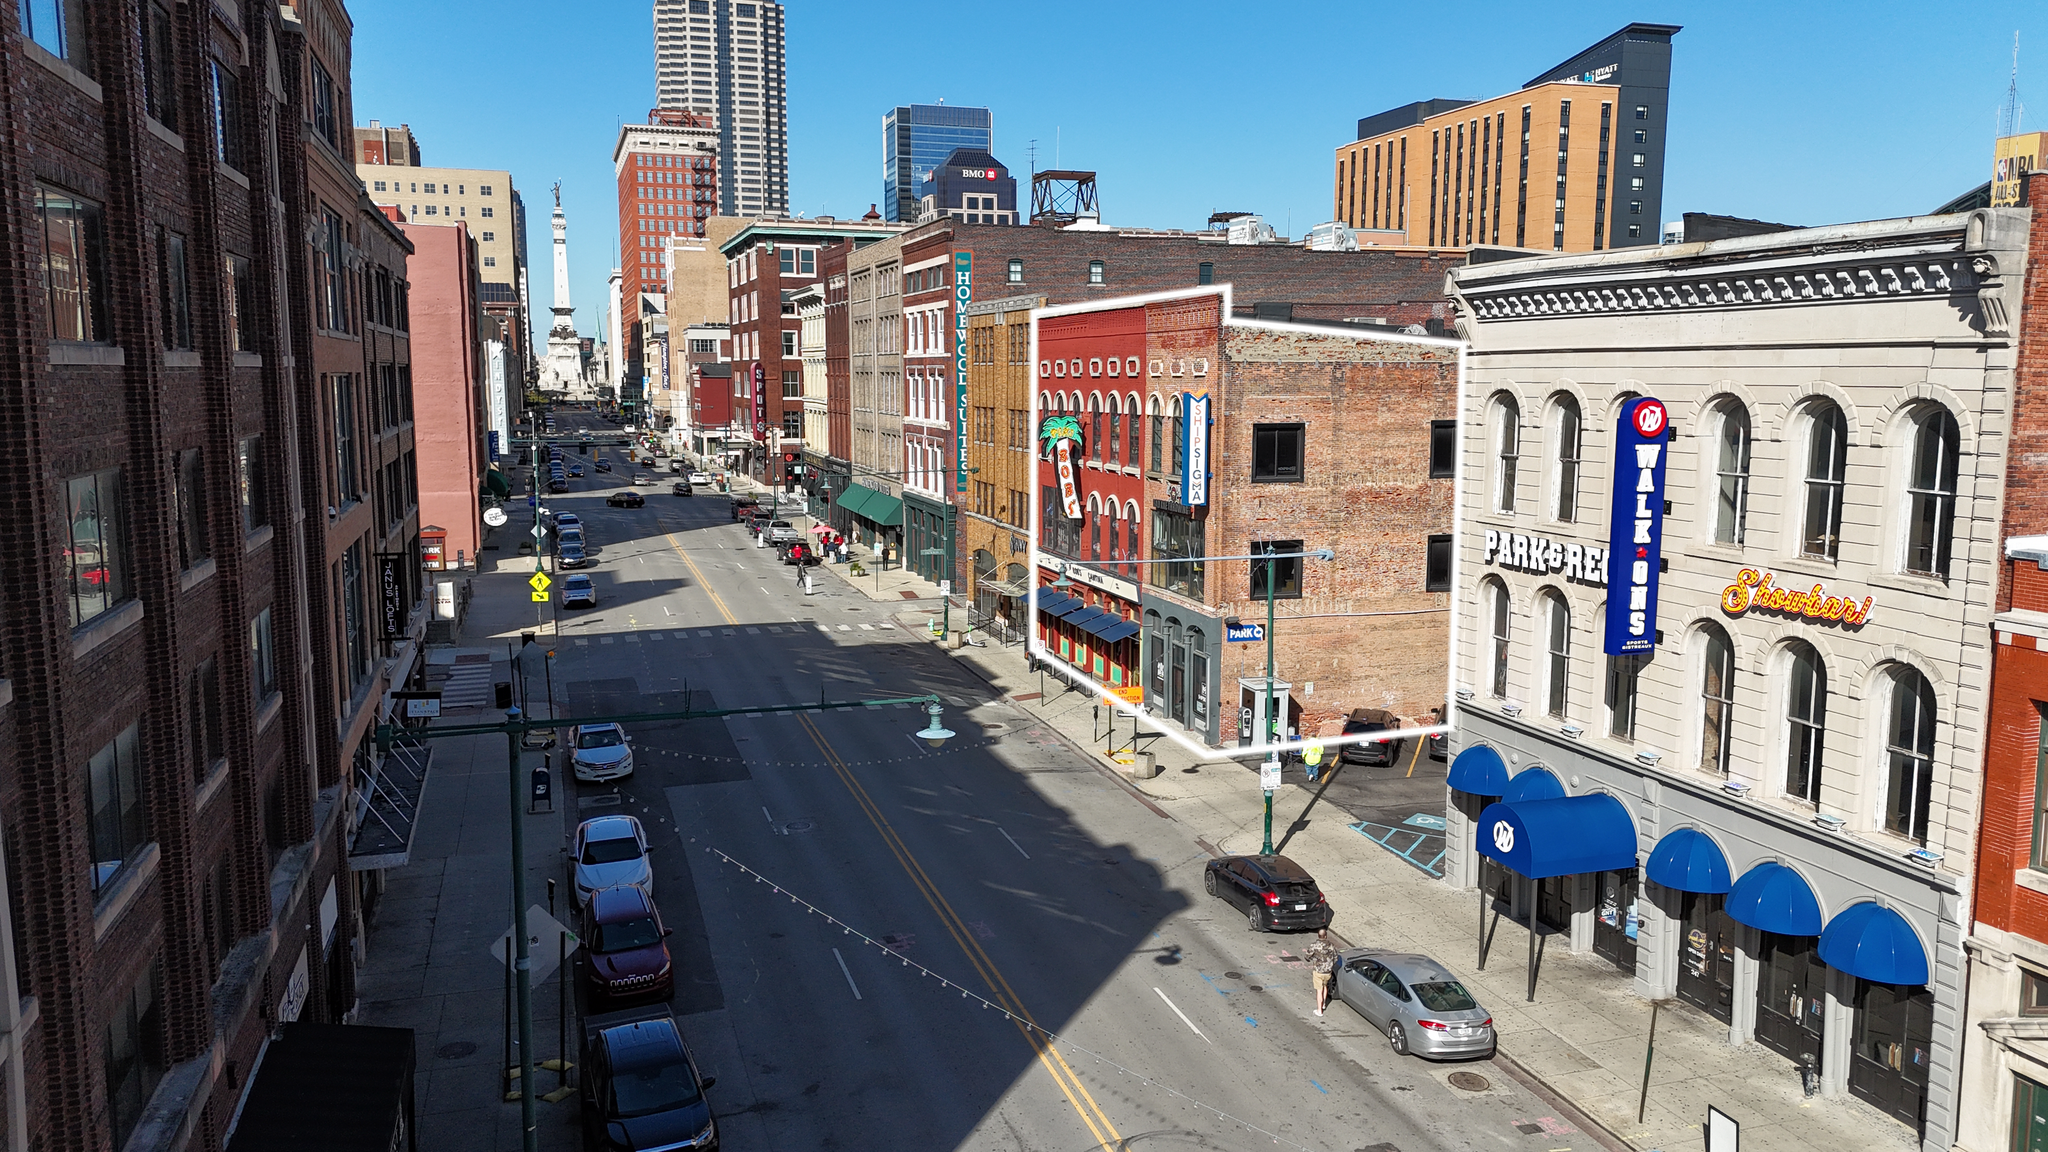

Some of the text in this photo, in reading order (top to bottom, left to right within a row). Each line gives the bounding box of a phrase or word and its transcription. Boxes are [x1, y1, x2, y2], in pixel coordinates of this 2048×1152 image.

[1595, 63, 1618, 78] HYATT
[962, 169, 985, 178] BMO
[2008, 154, 2033, 181] NBA
[660, 338, 668, 371] Hampton
[956, 271, 970, 475] HOMEWOOD SUITES
[1192, 404, 1202, 501] SHIPSIGMA
[421, 546, 441, 554] ARK
[384, 561, 396, 633] JANUS LOFTS
[1721, 568, 1873, 625] Showbar!
[1229, 627, 1254, 639] PARK
